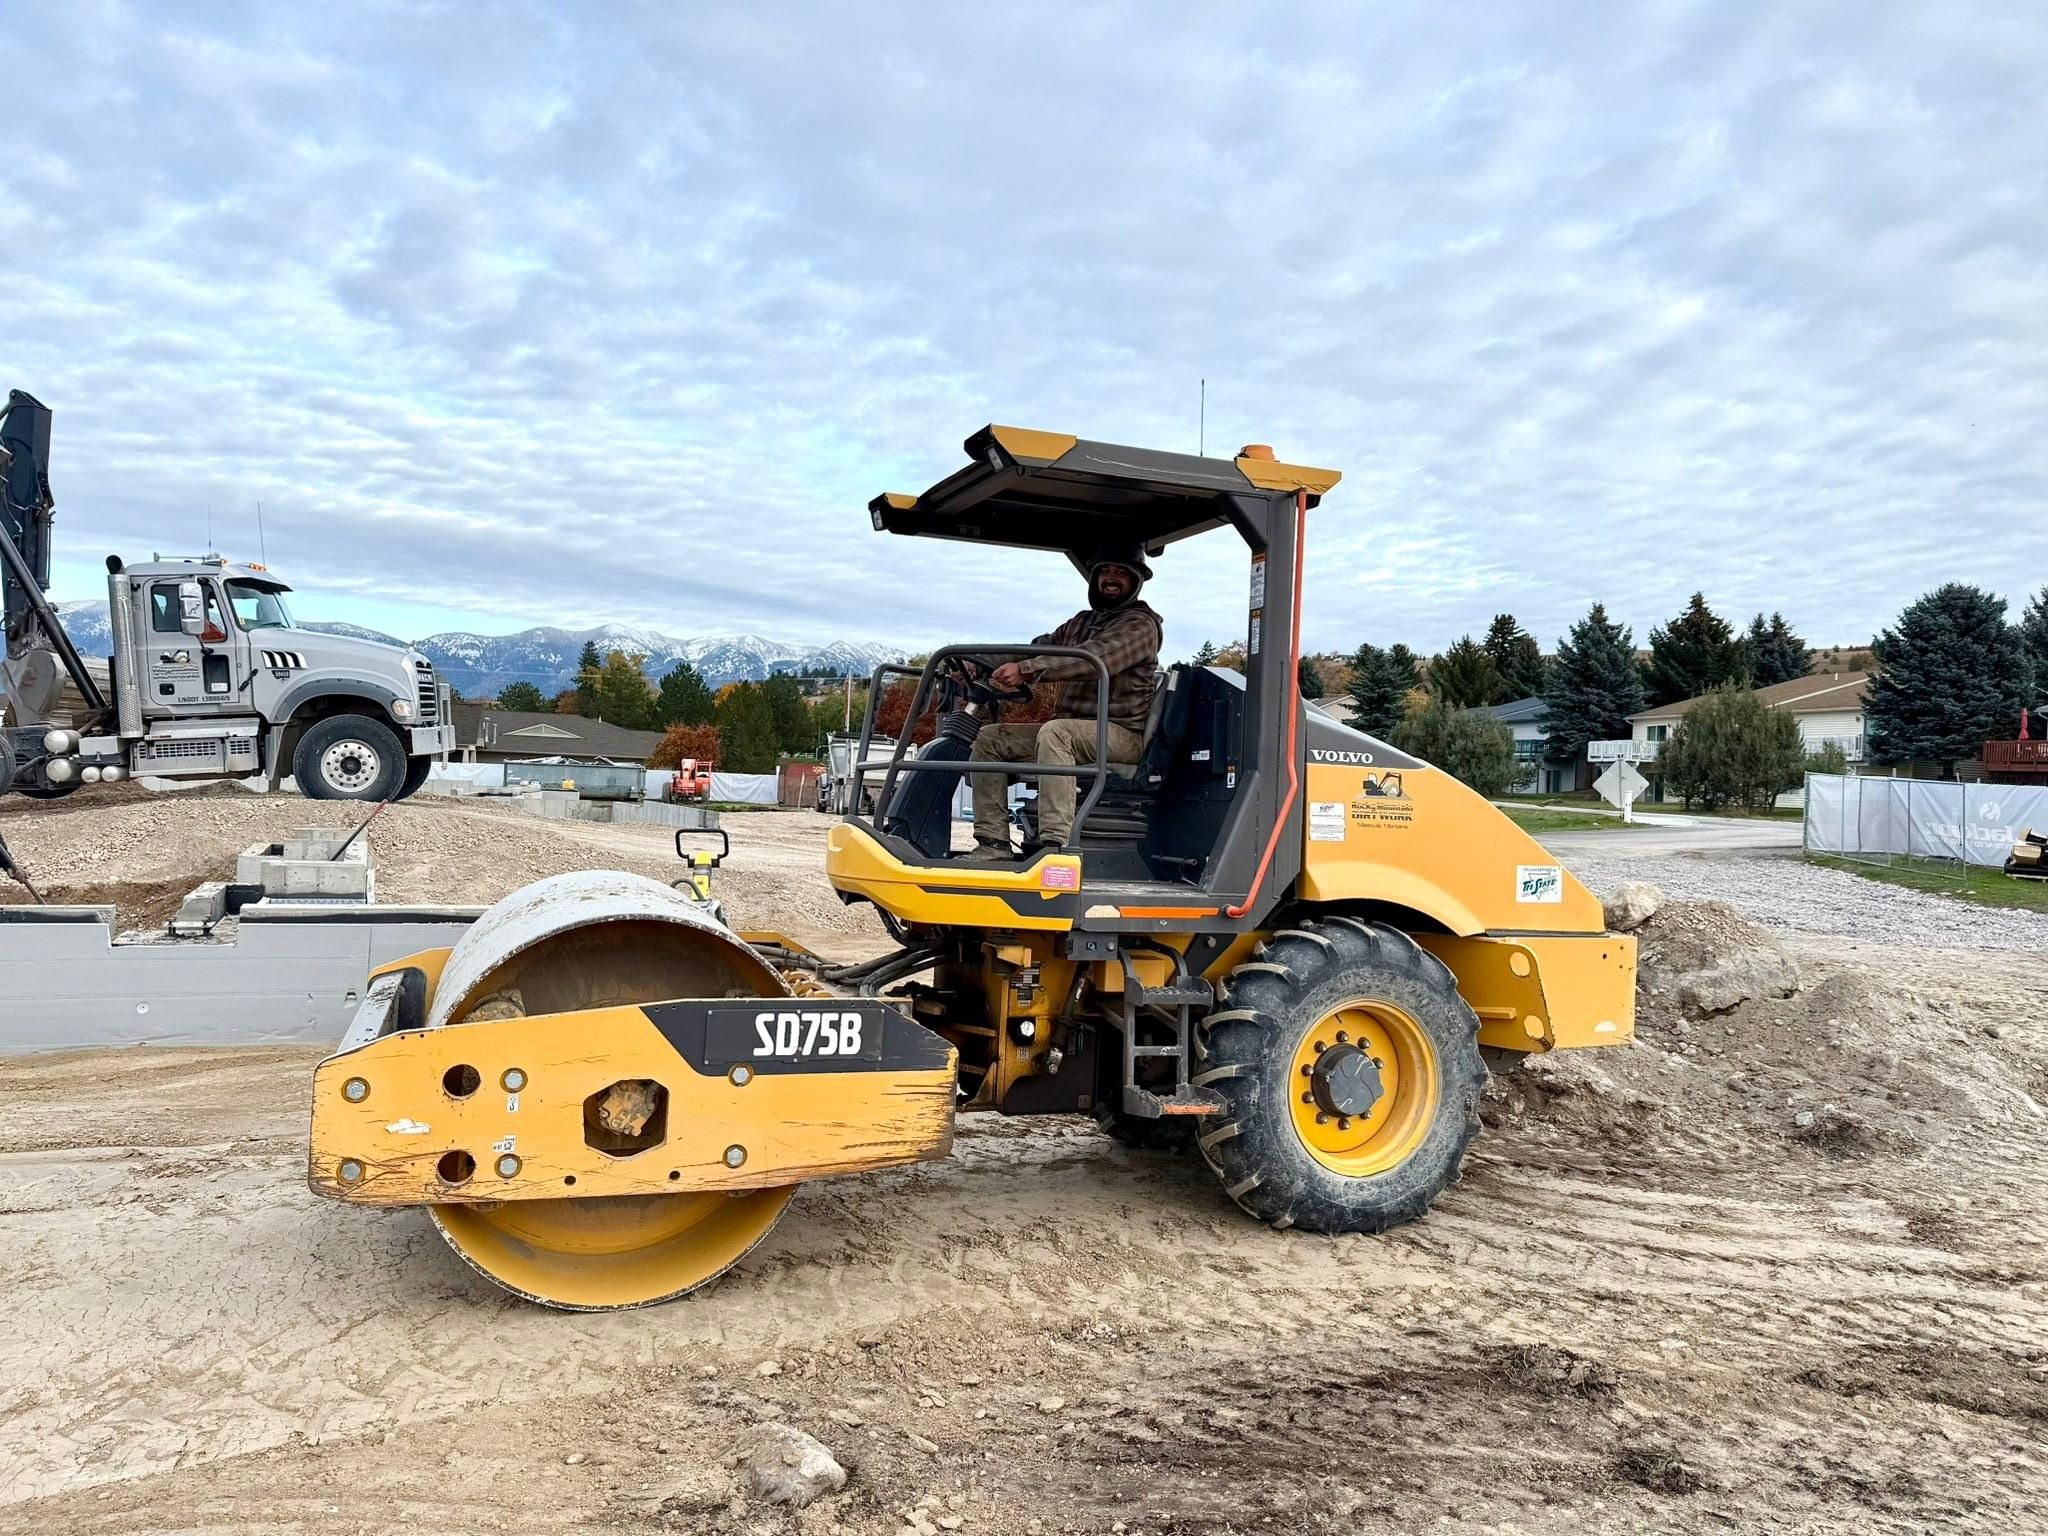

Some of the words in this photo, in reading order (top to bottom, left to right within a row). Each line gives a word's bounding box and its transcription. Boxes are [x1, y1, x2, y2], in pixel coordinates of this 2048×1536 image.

[1310, 749, 1373, 764] VOLVO
[1531, 878, 1557, 896] STATE
[753, 1012, 862, 1056] SD75B
